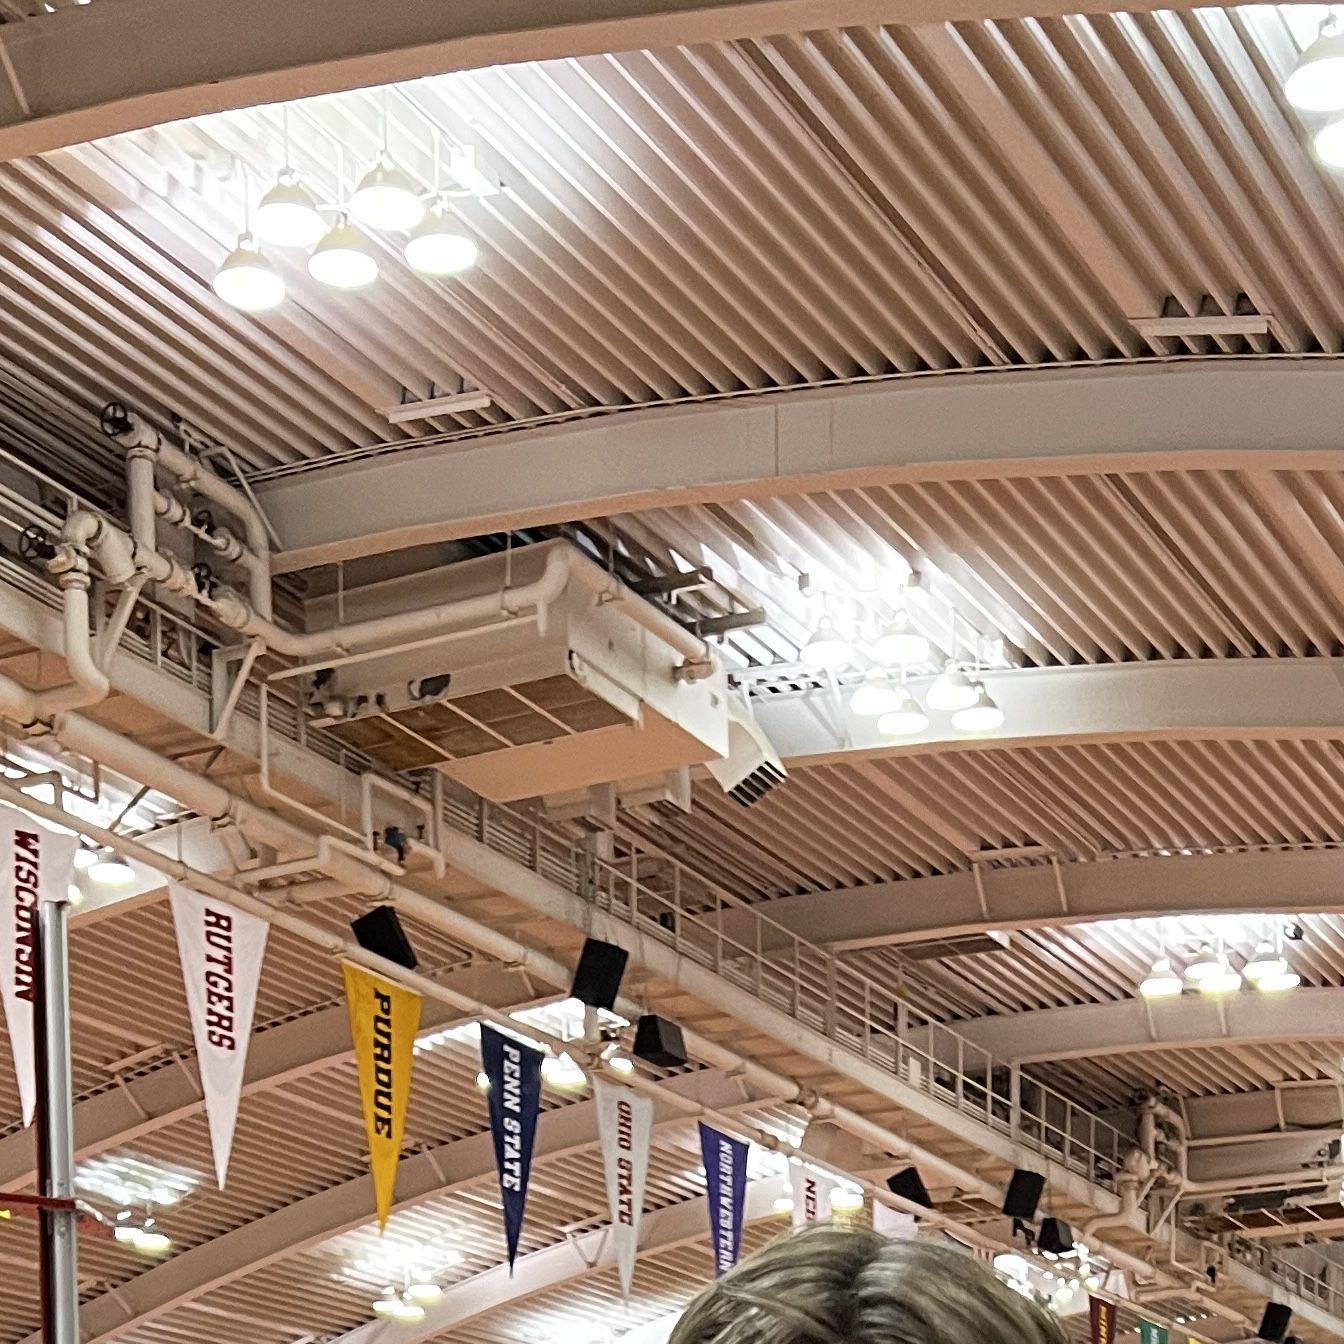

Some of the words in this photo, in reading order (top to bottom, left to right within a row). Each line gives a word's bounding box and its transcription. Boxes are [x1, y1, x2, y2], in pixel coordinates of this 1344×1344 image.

[14, 829, 40, 1002] WISCONSIN
[204, 907, 236, 1051] RUTGERS
[373, 987, 393, 1140] PURDUE
[502, 1043, 522, 1113] PENN
[502, 1117, 522, 1192] STATE
[617, 1100, 633, 1151] OHIO
[617, 1157, 633, 1227] STATE
